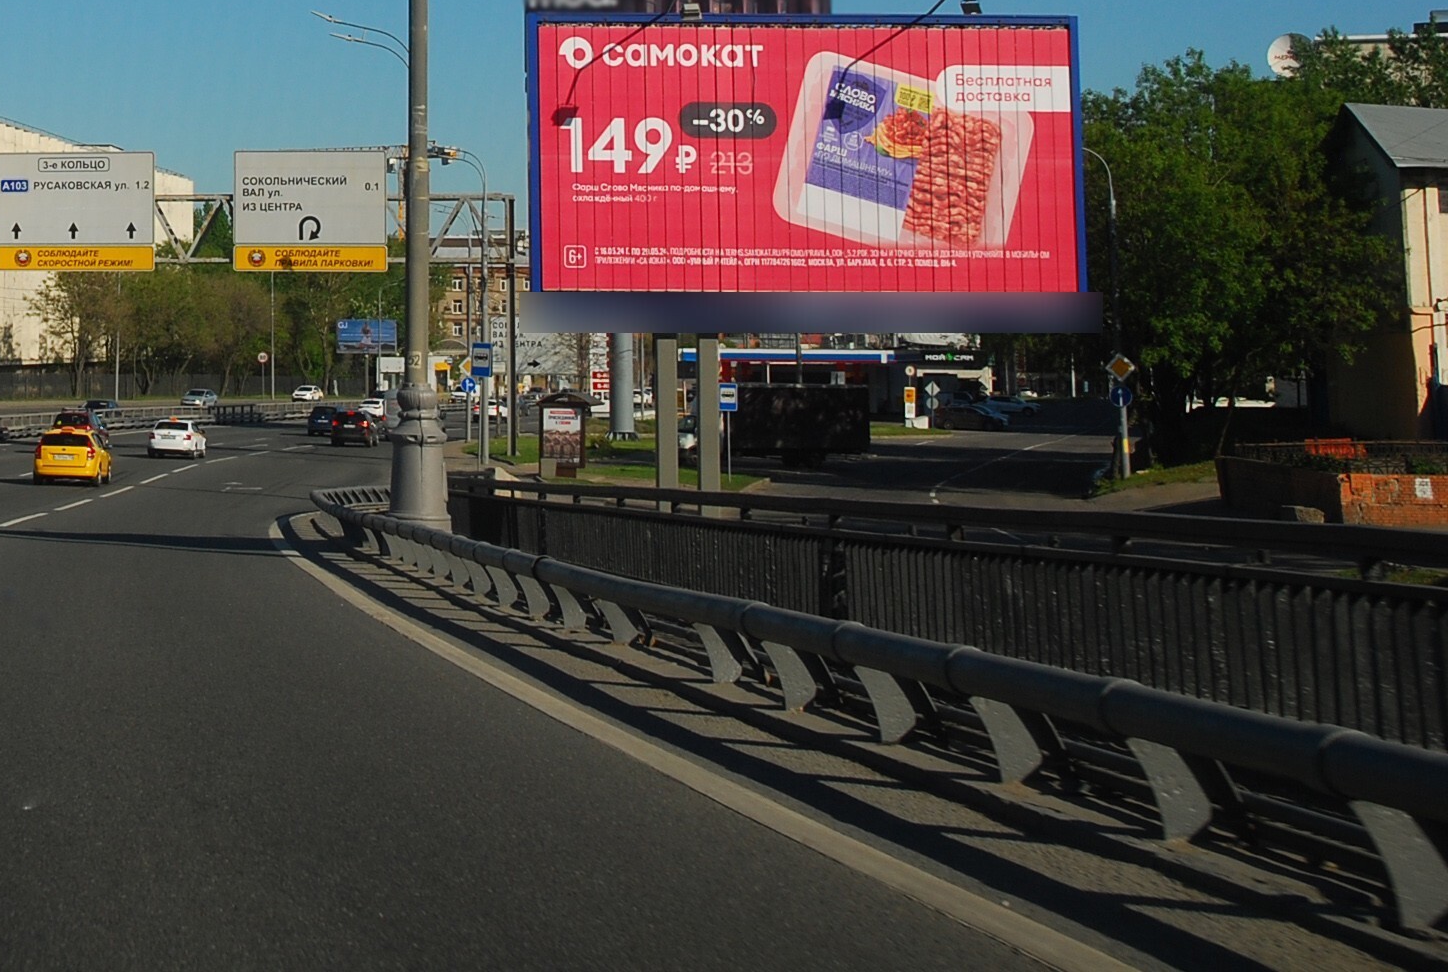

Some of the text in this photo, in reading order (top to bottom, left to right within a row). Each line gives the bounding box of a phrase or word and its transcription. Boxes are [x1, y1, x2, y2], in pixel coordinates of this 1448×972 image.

[602, 42, 764, 67] самокат
[955, 73, 1052, 87] Бесплатная
[955, 91, 1030, 103] доставка
[61, 160, 105, 170] КОЛЬЦО
[709, 151, 754, 174] 213
[34, 181, 111, 190] РУСАКОВСКАЯ
[114, 182, 129, 191] ул.
[136, 181, 150, 190] 1.2
[242, 176, 347, 186] СОКОЛЬНИЧЕСКИЙ
[364, 183, 379, 191] 0.1
[242, 188, 283, 198] ВАЛ ул.
[242, 203, 303, 212] ИЗ ЦЕНТРА
[37, 250, 99, 258] СОБЛЮДАЙТЕ
[275, 249, 341, 258] СОБЛЮДАЙТЕ
[568, 249, 582, 264] 6+
[37, 259, 133, 267] СКОРОСТНОЙ РЕЖИМ!
[274, 259, 373, 267] ПРАВИЛА ПАРКОВКИ!
[515, 340, 542, 348] ЕНТРА
